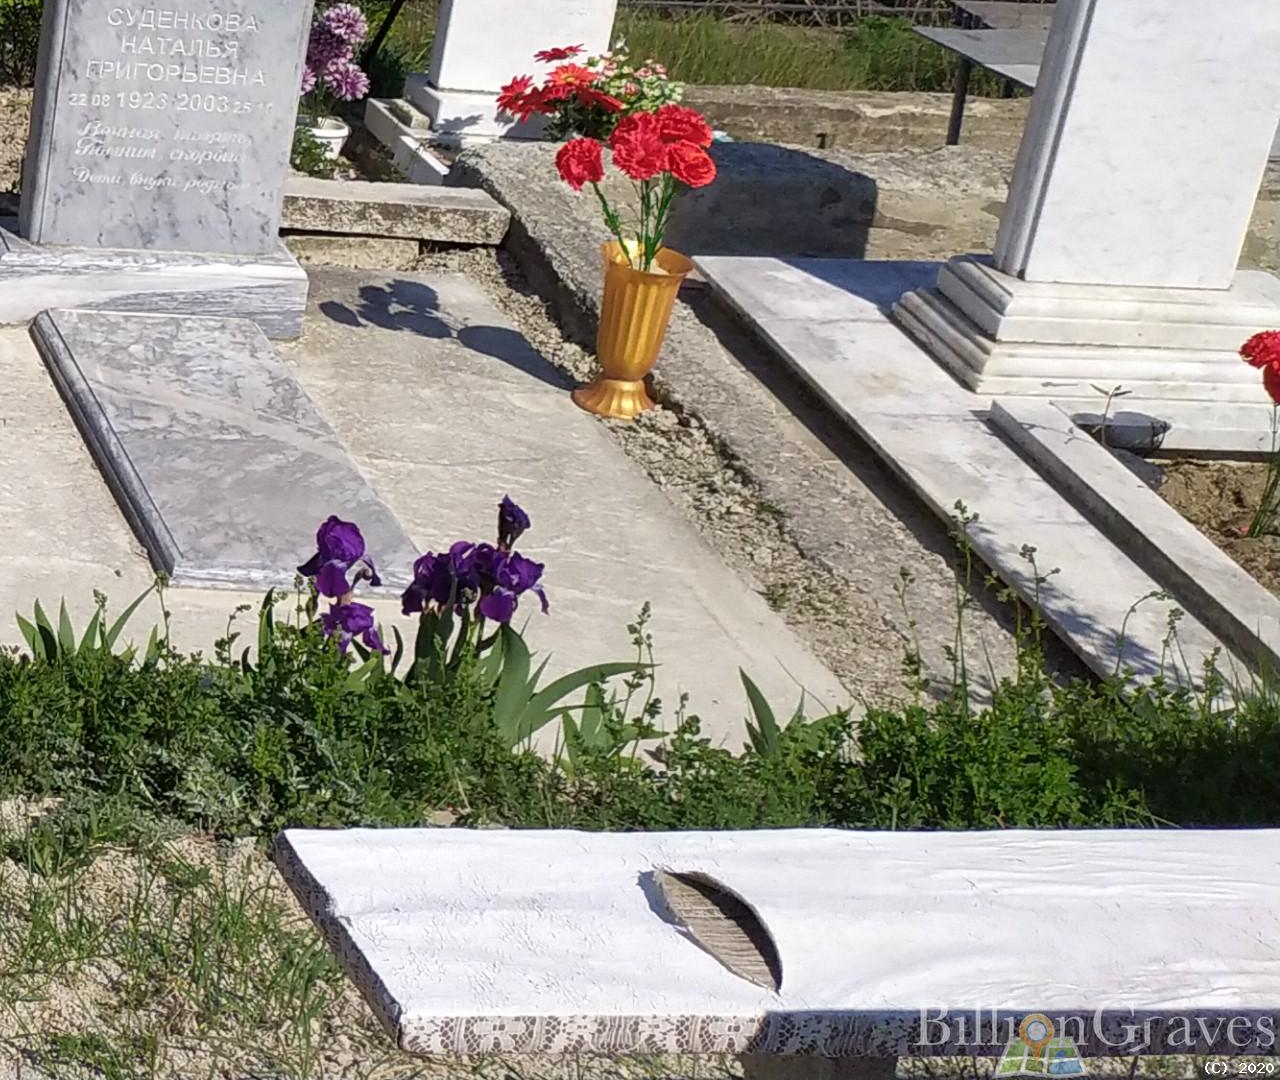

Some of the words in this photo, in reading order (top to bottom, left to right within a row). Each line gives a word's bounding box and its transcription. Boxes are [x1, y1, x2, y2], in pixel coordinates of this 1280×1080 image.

[107, 7, 260, 32] СУДЕНКОВА
[120, 36, 239, 59] НАТАЛЬЯ
[85, 60, 267, 87] ГРИГОРЬЕВНА
